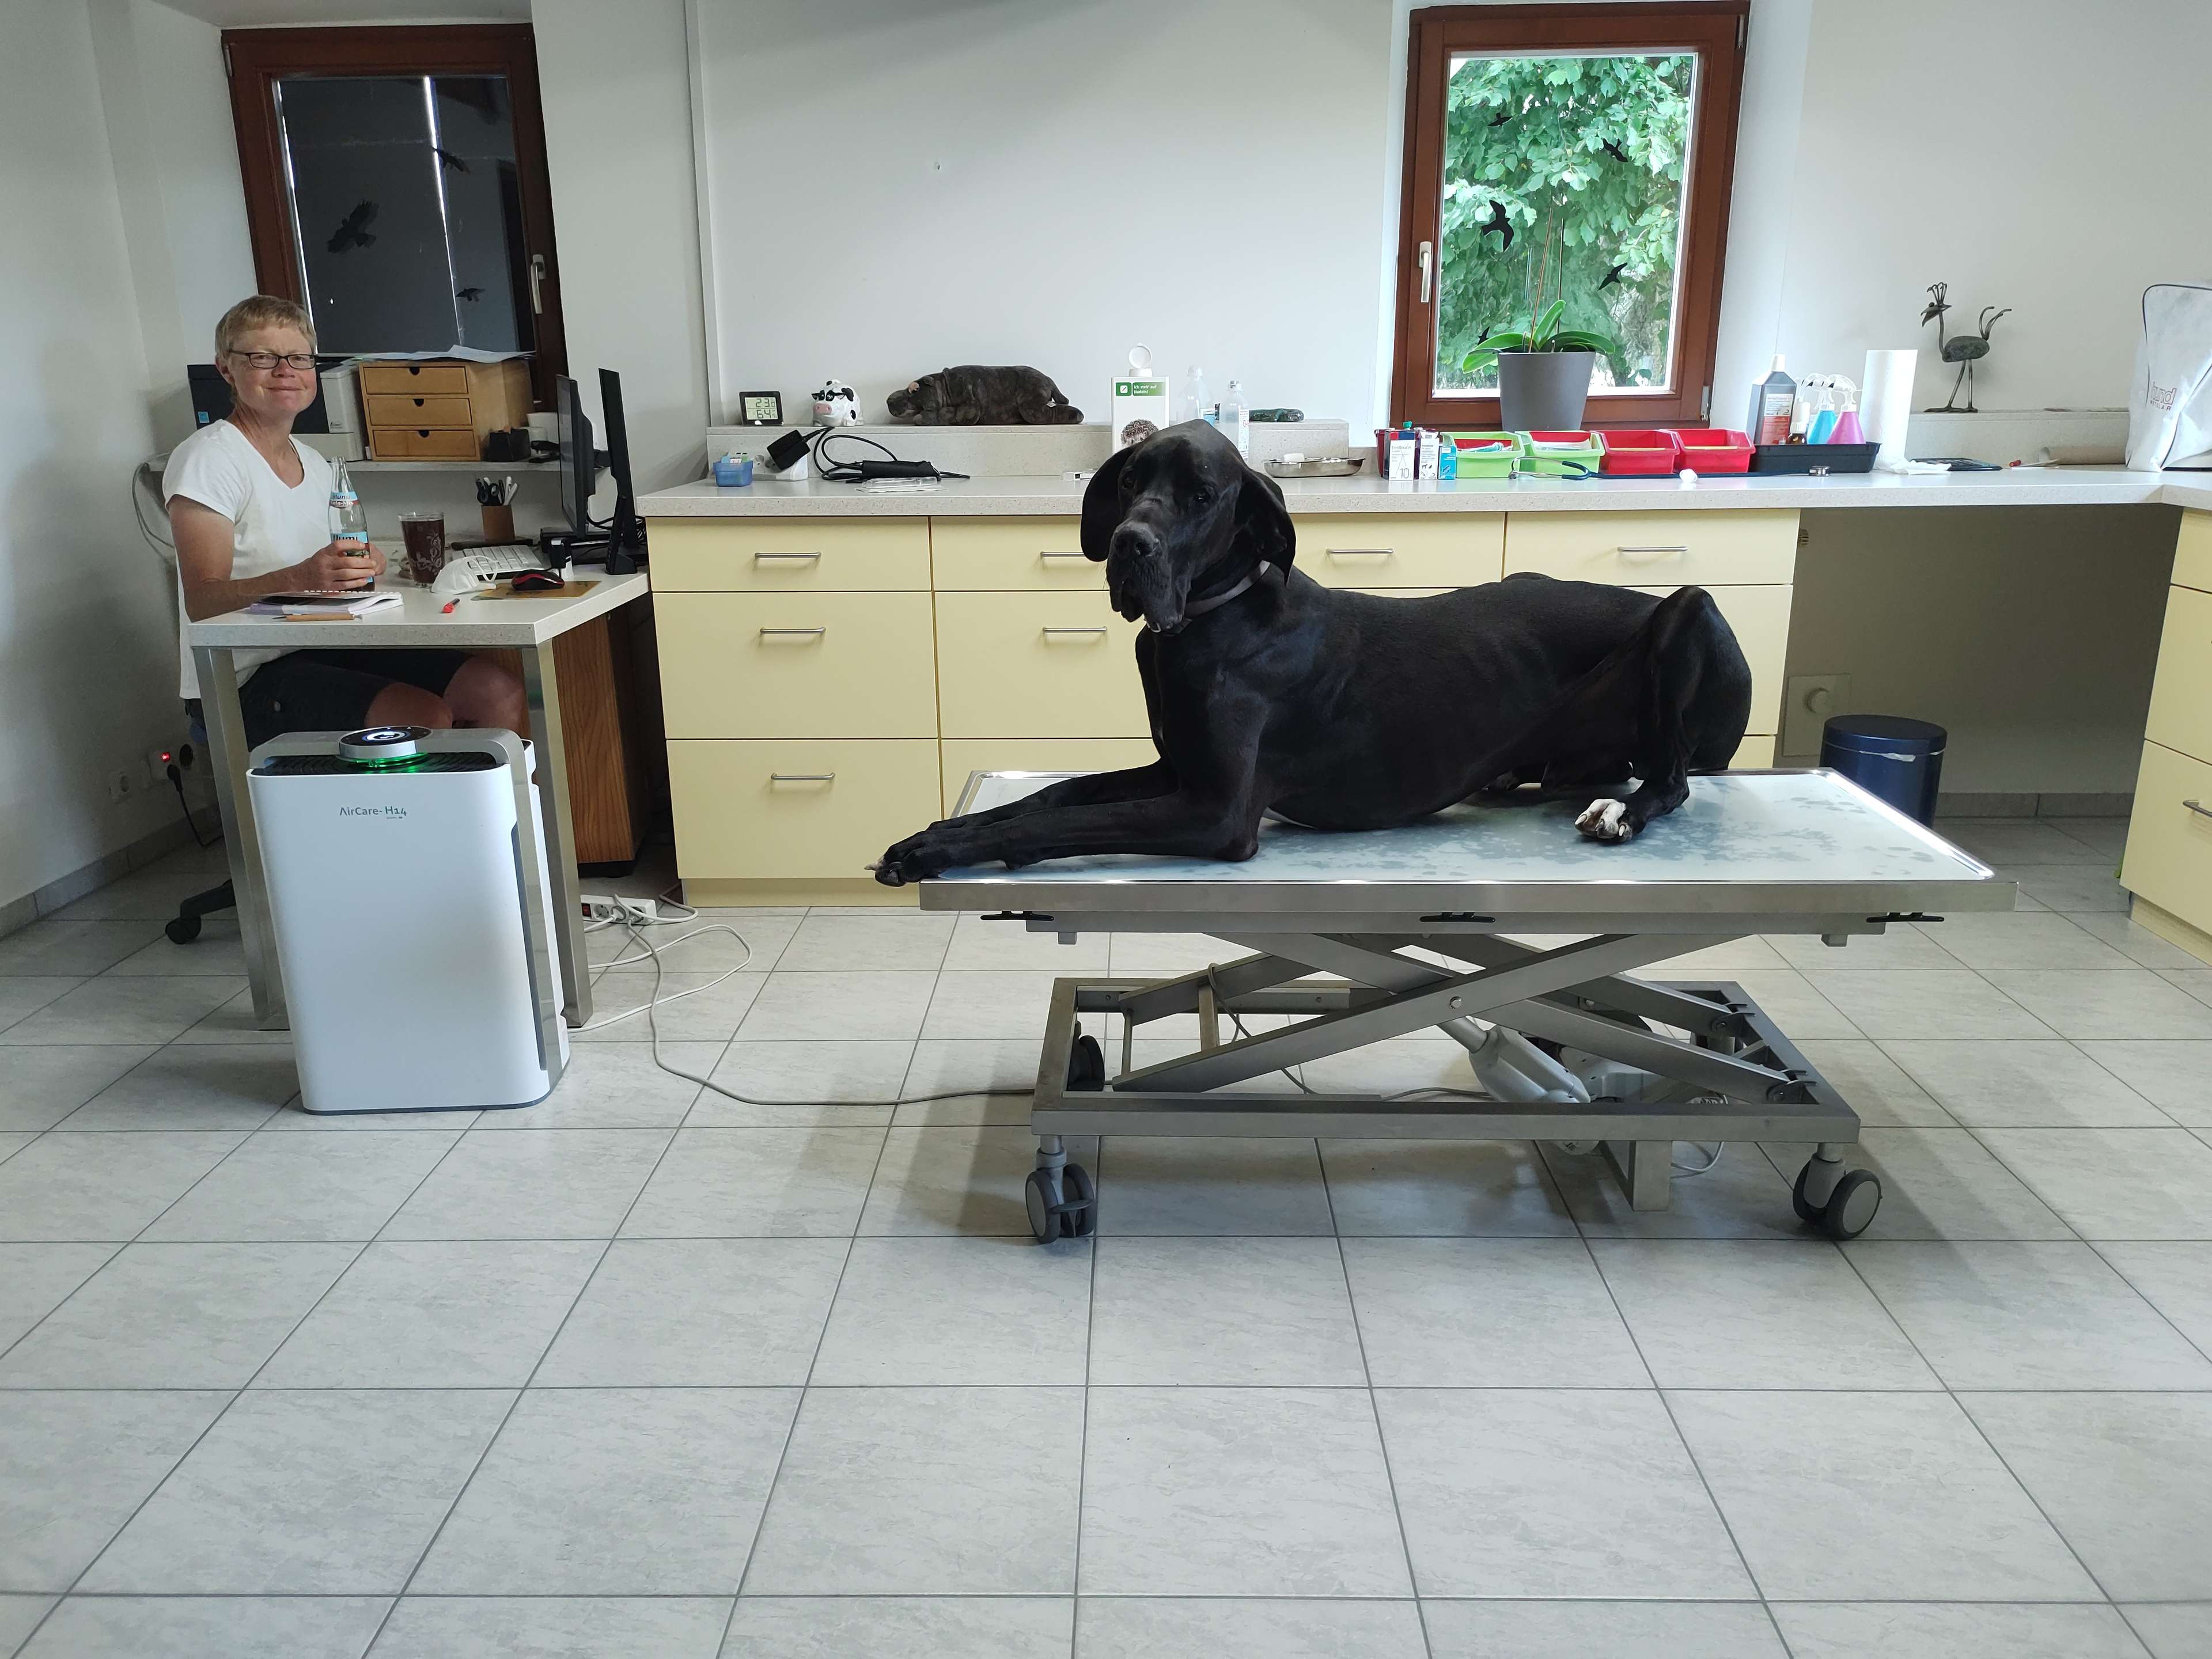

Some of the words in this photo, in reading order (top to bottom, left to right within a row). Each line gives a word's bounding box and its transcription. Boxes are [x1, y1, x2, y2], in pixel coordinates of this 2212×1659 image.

[756, 409, 771, 419] 64
[1400, 468, 1410, 479] 10
[385, 806, 407, 816] H14
